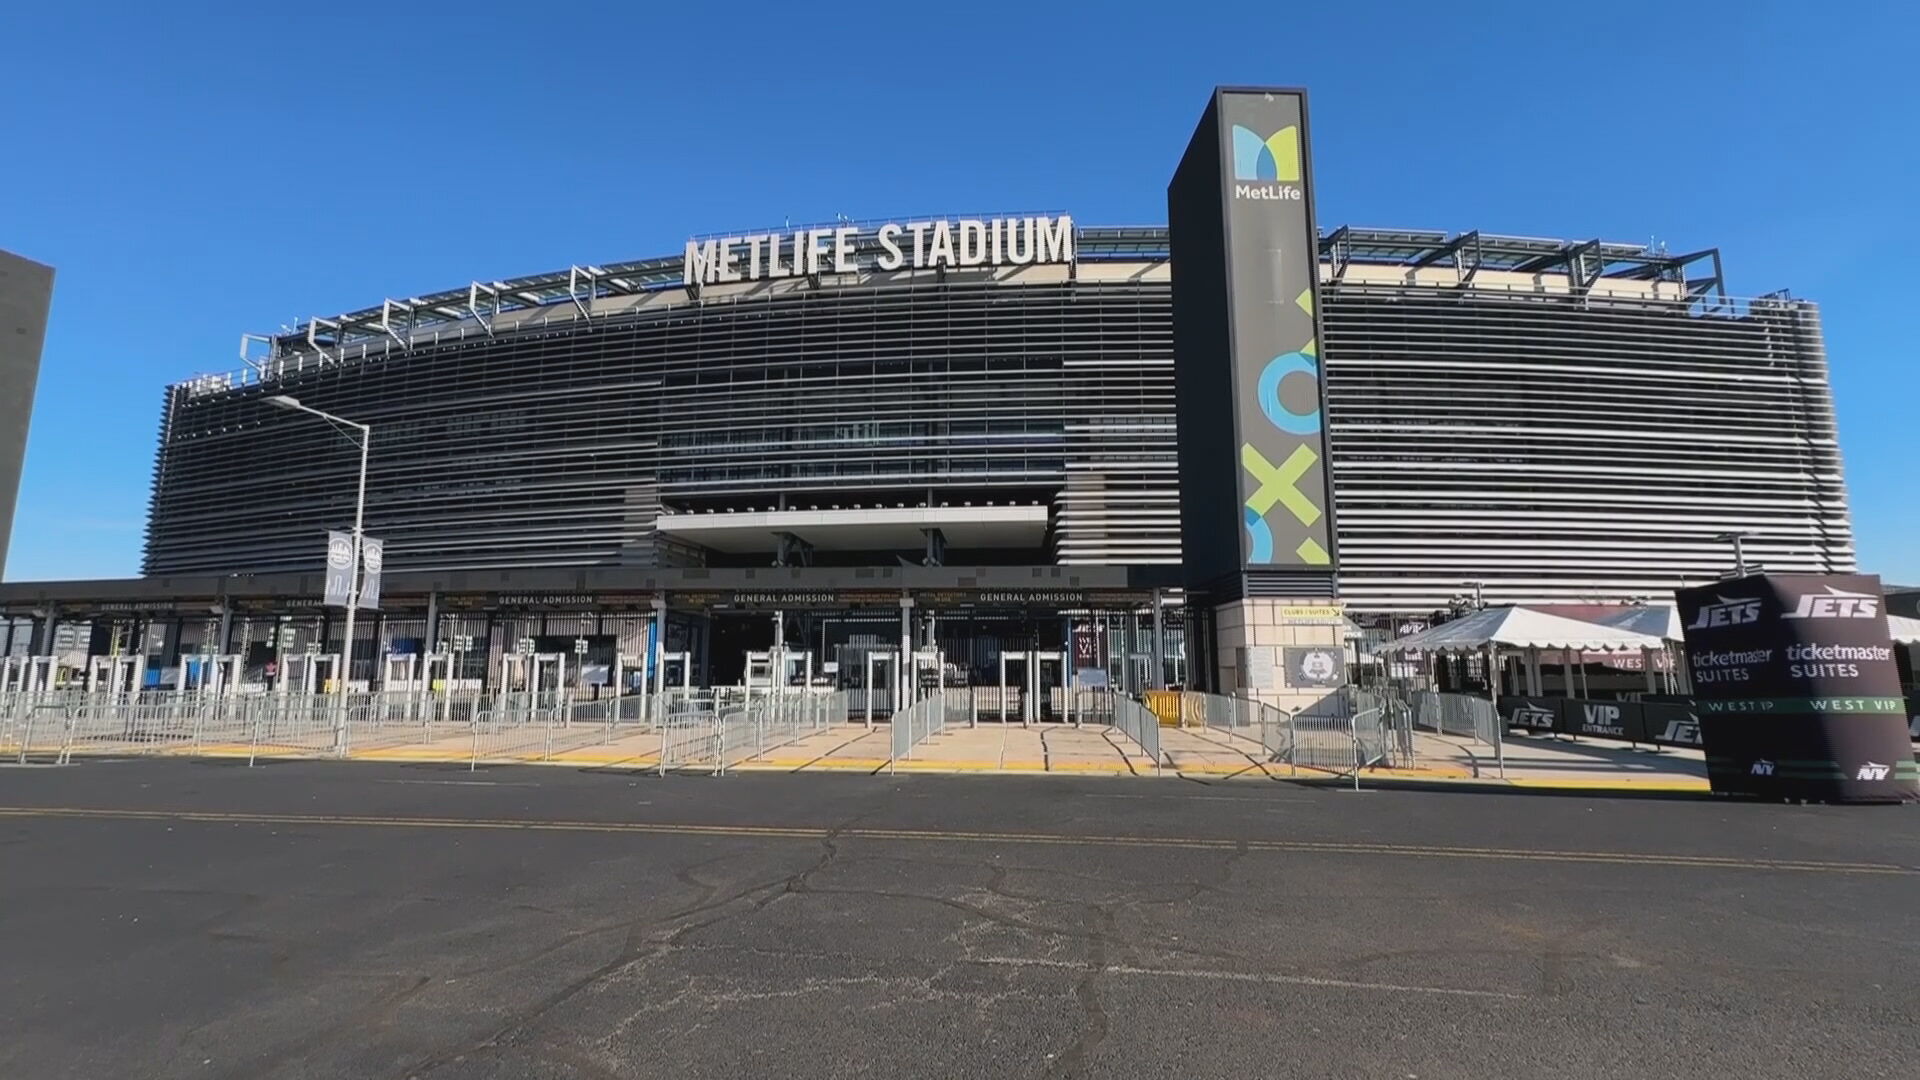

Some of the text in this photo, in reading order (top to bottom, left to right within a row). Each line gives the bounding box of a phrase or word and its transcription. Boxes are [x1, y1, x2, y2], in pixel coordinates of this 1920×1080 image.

[1235, 184, 1301, 201] MetLife
[683, 215, 1073, 286] METLIFE STADIUM
[499, 595, 540, 605] GENERAL
[543, 595, 593, 605] ADMISSION
[734, 594, 778, 602] GENERAL
[781, 594, 835, 602] ADMISSION
[980, 593, 1026, 602] GENERAL
[1029, 593, 1084, 602] ADMISSION
[1780, 588, 1880, 619] JETS
[1688, 597, 1762, 630] JETS
[1786, 643, 1891, 662] ticketmaster
[1612, 658, 1647, 669] WES
[1790, 664, 1859, 678] SUITES
[1696, 668, 1750, 683] SUITES
[1708, 701, 1756, 711] WEST
[1810, 700, 1897, 711] WEST VIP
[1507, 704, 1555, 728] JETS
[1583, 704, 1620, 725] VIP
[1582, 723, 1625, 737] ENTRANCE
[1655, 719, 1704, 744] JE
[1750, 763, 1775, 776] NY
[1856, 764, 1890, 781] NY
